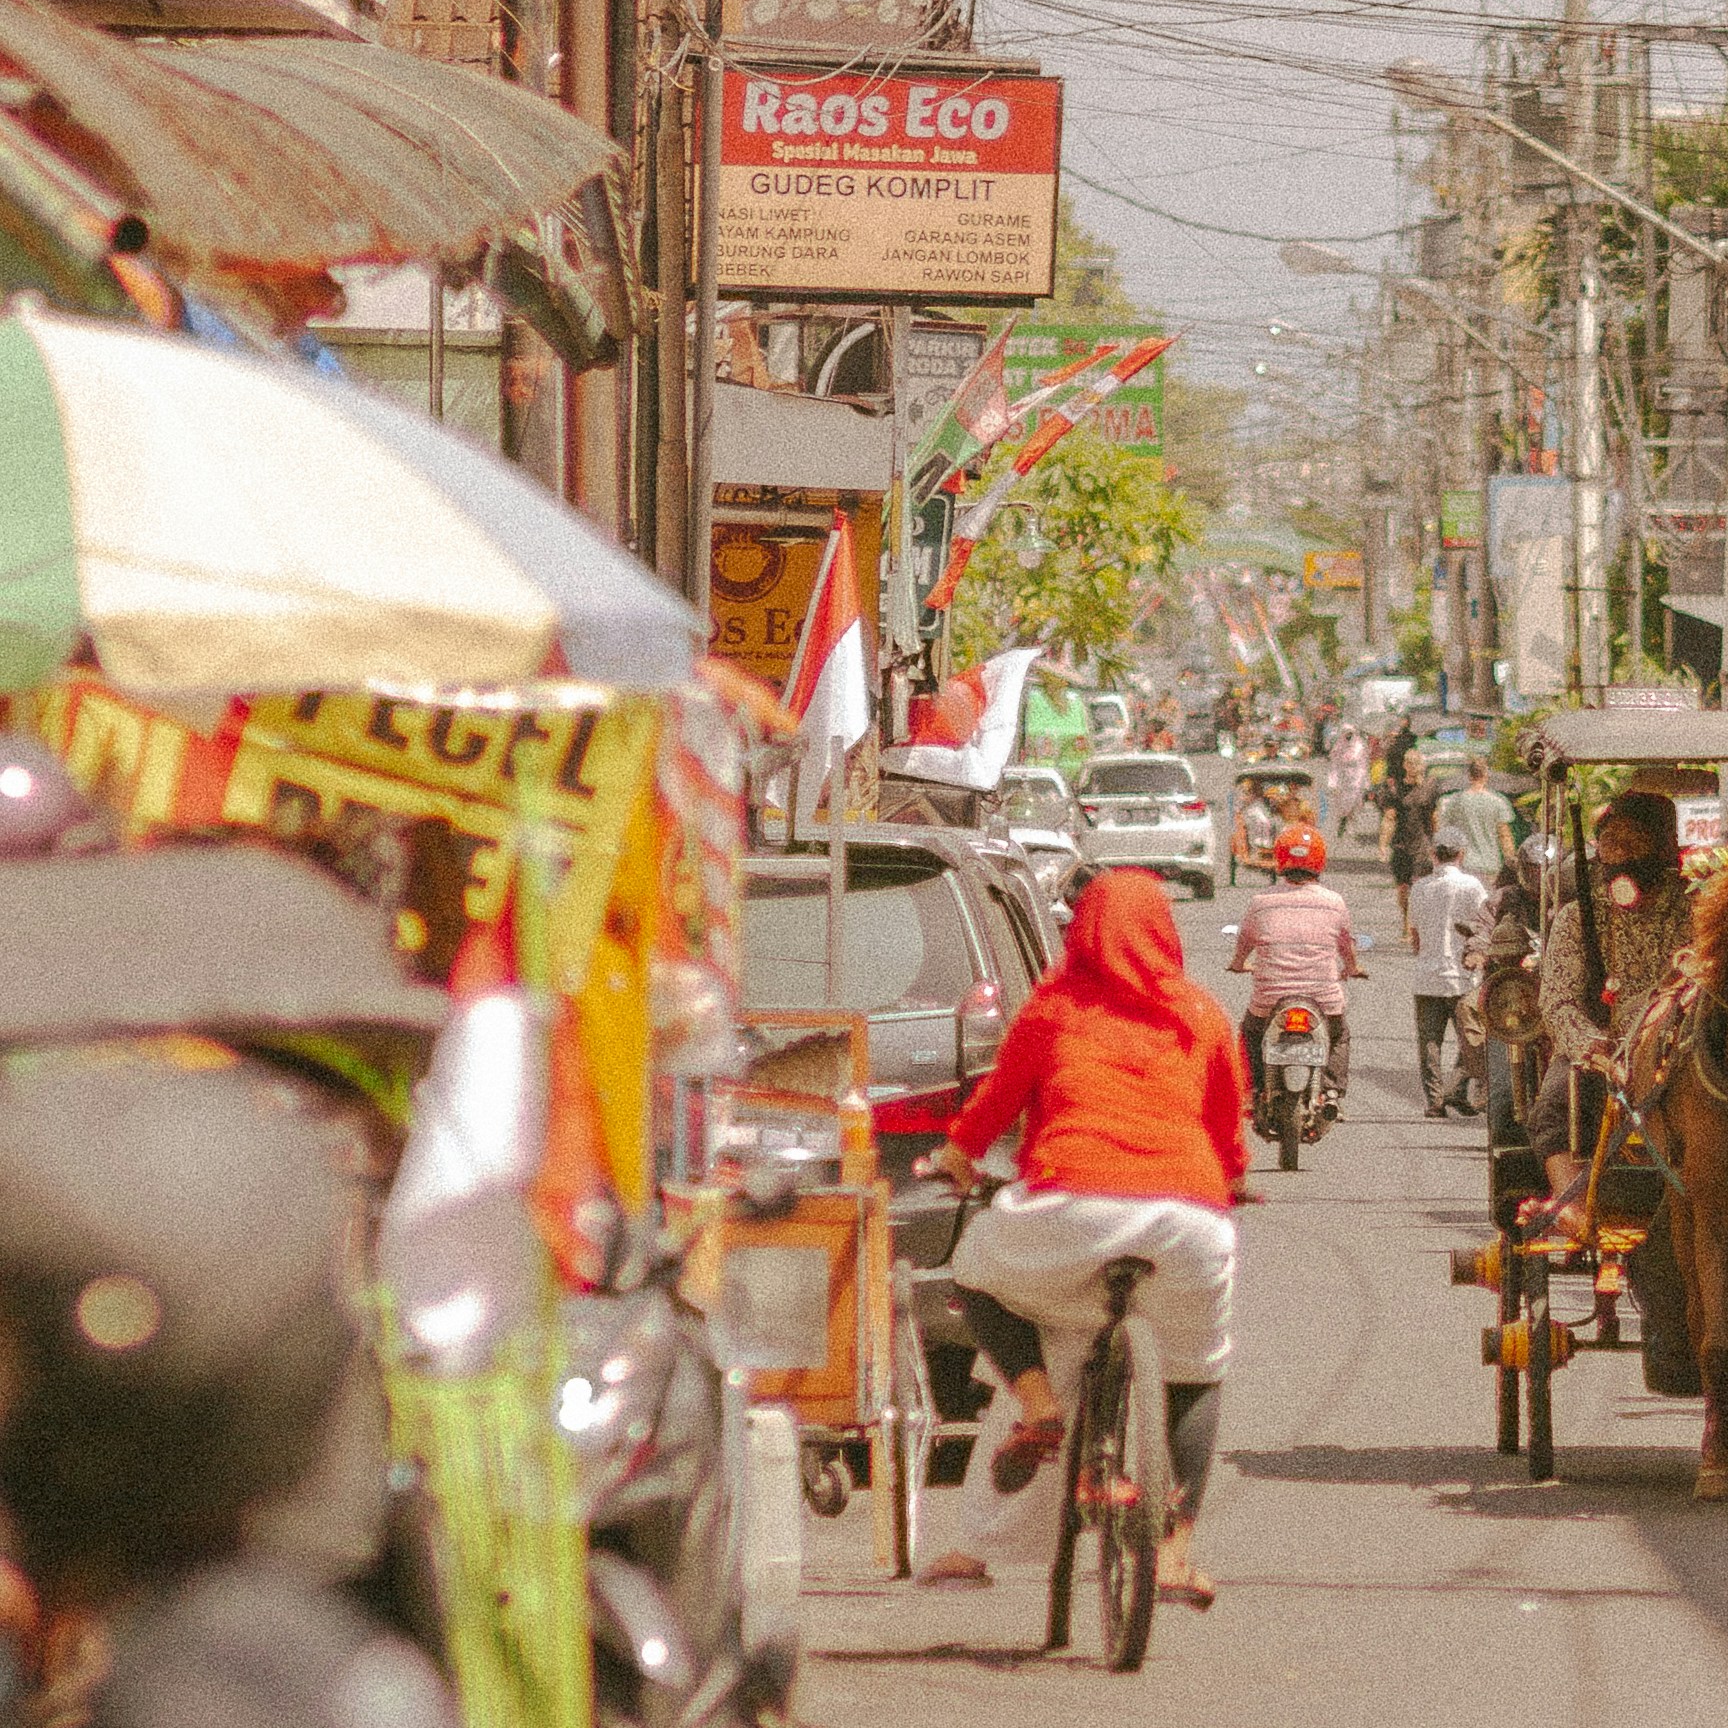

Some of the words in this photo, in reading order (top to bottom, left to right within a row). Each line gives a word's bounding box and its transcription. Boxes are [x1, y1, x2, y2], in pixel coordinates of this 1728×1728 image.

[742, 80, 890, 137] Raos
[905, 86, 1010, 141] Eco
[772, 139, 840, 163] Spesial
[843, 142, 925, 164] Masakan
[930, 145, 979, 165] Jawa
[751, 172, 855, 196] GUDEG
[867, 176, 997, 202] KOMPLIT
[759, 208, 812, 222] LIWET
[957, 212, 1032, 229] GURAME
[764, 227, 851, 242] KAMPUNG
[905, 229, 979, 245] GARANG
[983, 231, 1031, 247] ASEM
[792, 245, 840, 260] DARA
[882, 247, 950, 263] JANGAN
[956, 250, 1031, 266] LOMBOK
[922, 268, 987, 282] RAWON
[990, 270, 1030, 284] SAPI
